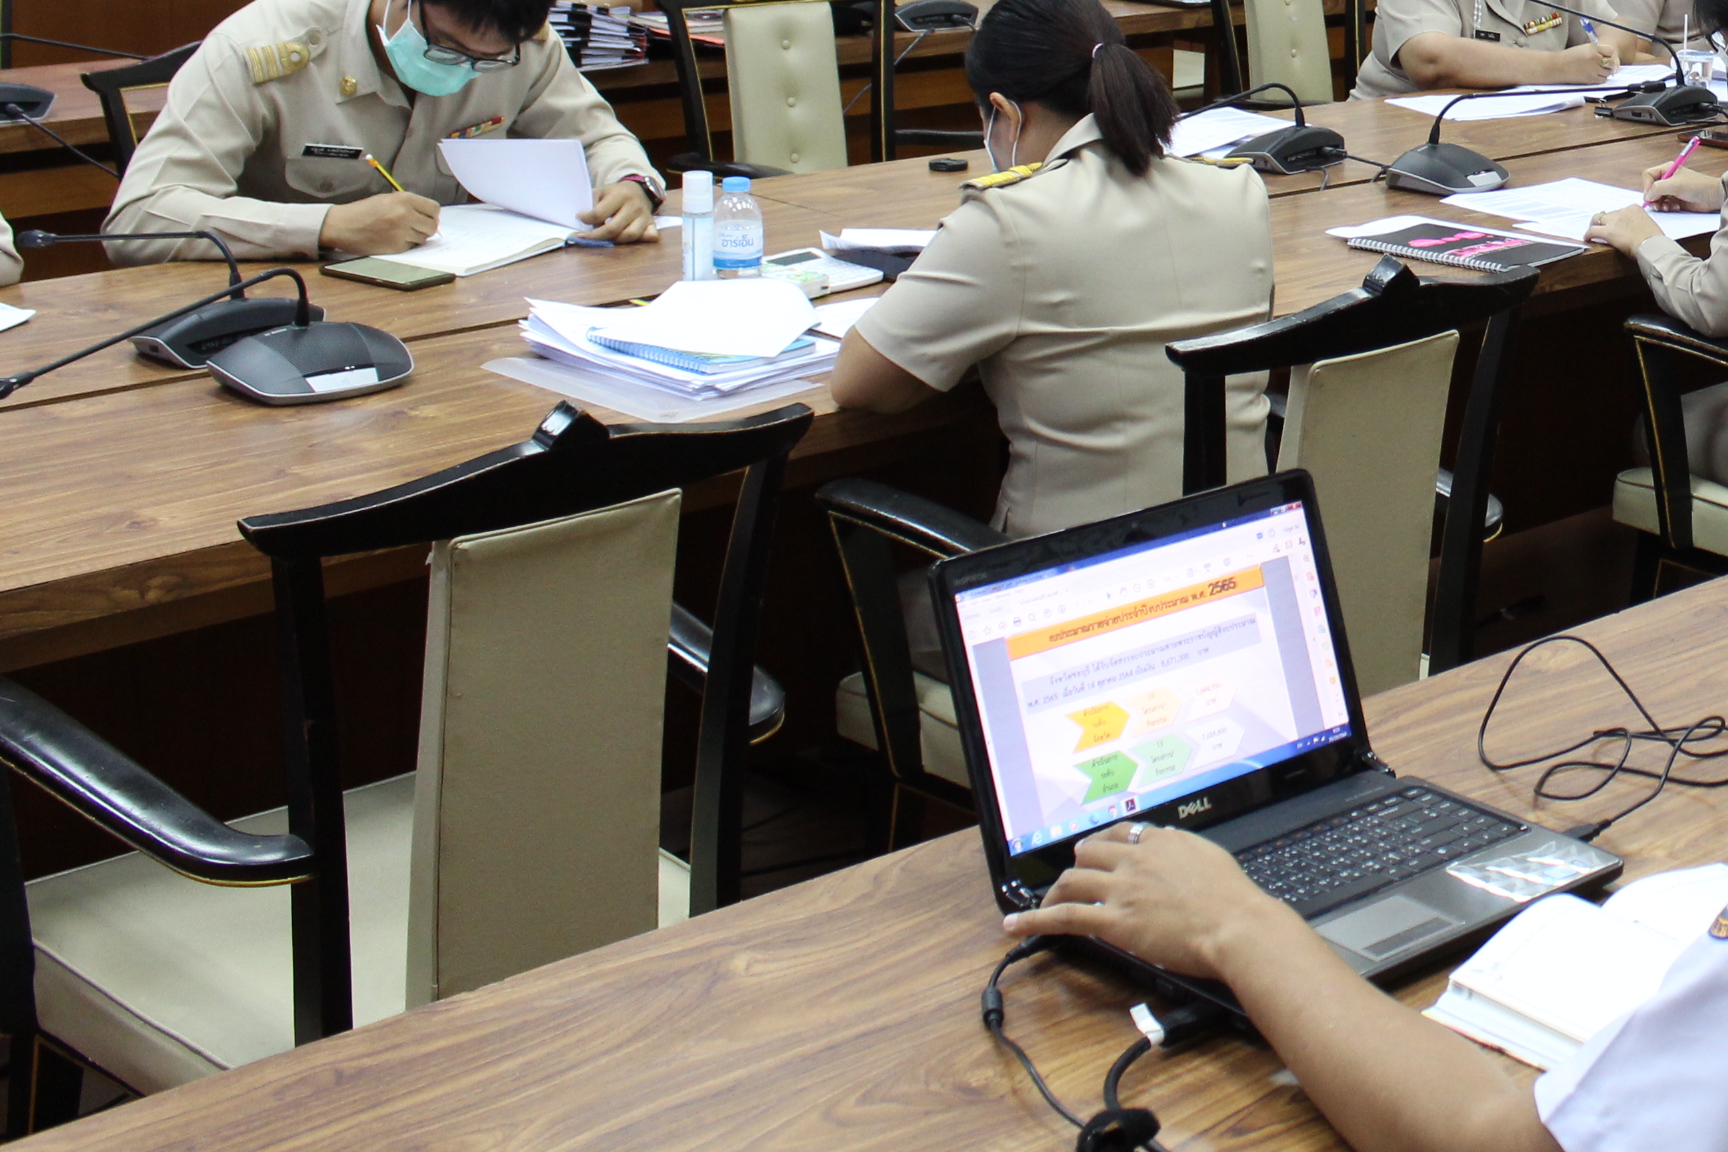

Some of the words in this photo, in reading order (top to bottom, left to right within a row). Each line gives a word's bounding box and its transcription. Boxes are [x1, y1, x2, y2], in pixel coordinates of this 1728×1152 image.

[1207, 577, 1237, 597] 2565
[1042, 693, 1059, 705] 2565
[1118, 669, 1134, 682] 2564
[1178, 797, 1212, 820] DELL
